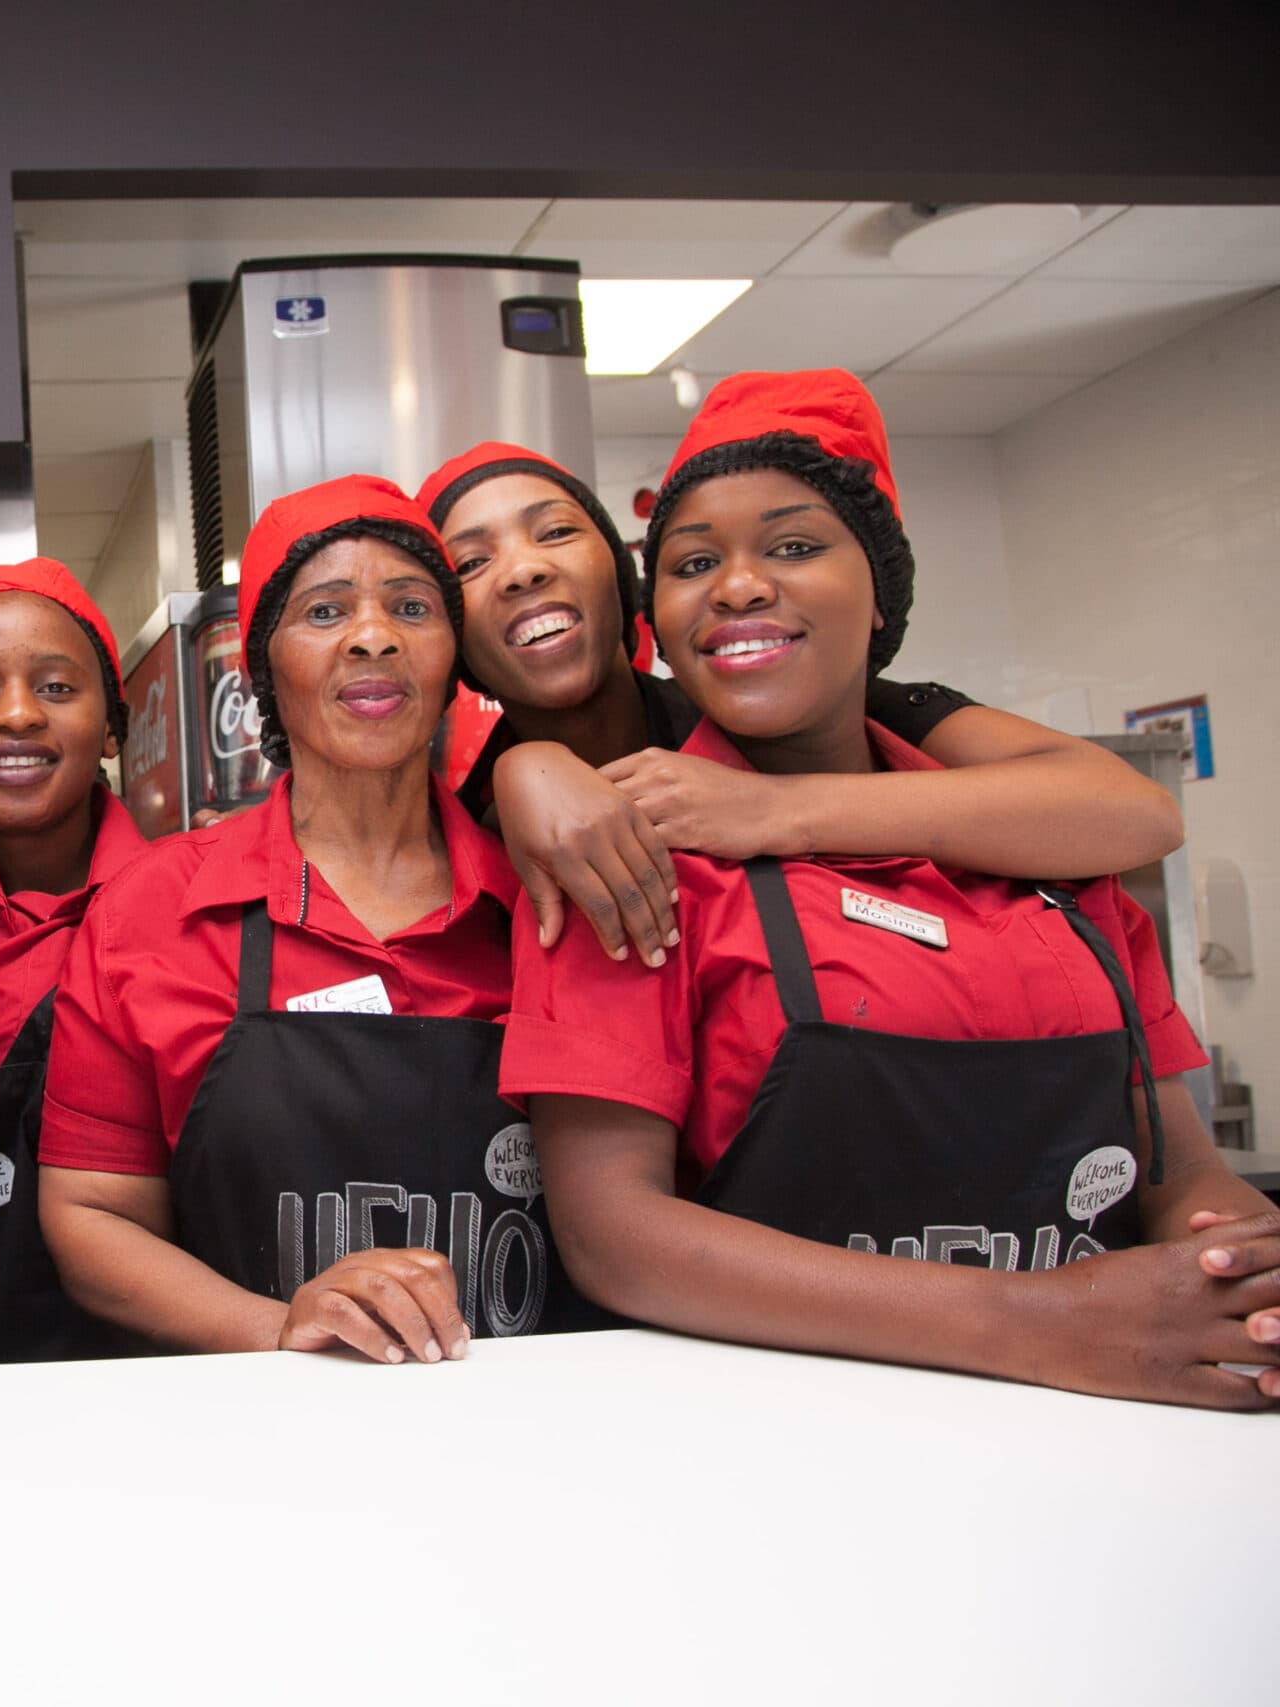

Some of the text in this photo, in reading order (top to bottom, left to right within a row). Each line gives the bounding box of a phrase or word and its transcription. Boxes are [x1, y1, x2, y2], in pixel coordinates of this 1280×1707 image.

[855, 904, 926, 934] Mosima
[494, 1136, 536, 1165] WELCO
[1074, 1160, 1127, 1192] WELCOME
[1070, 1181, 1126, 1211] EVERYONE
